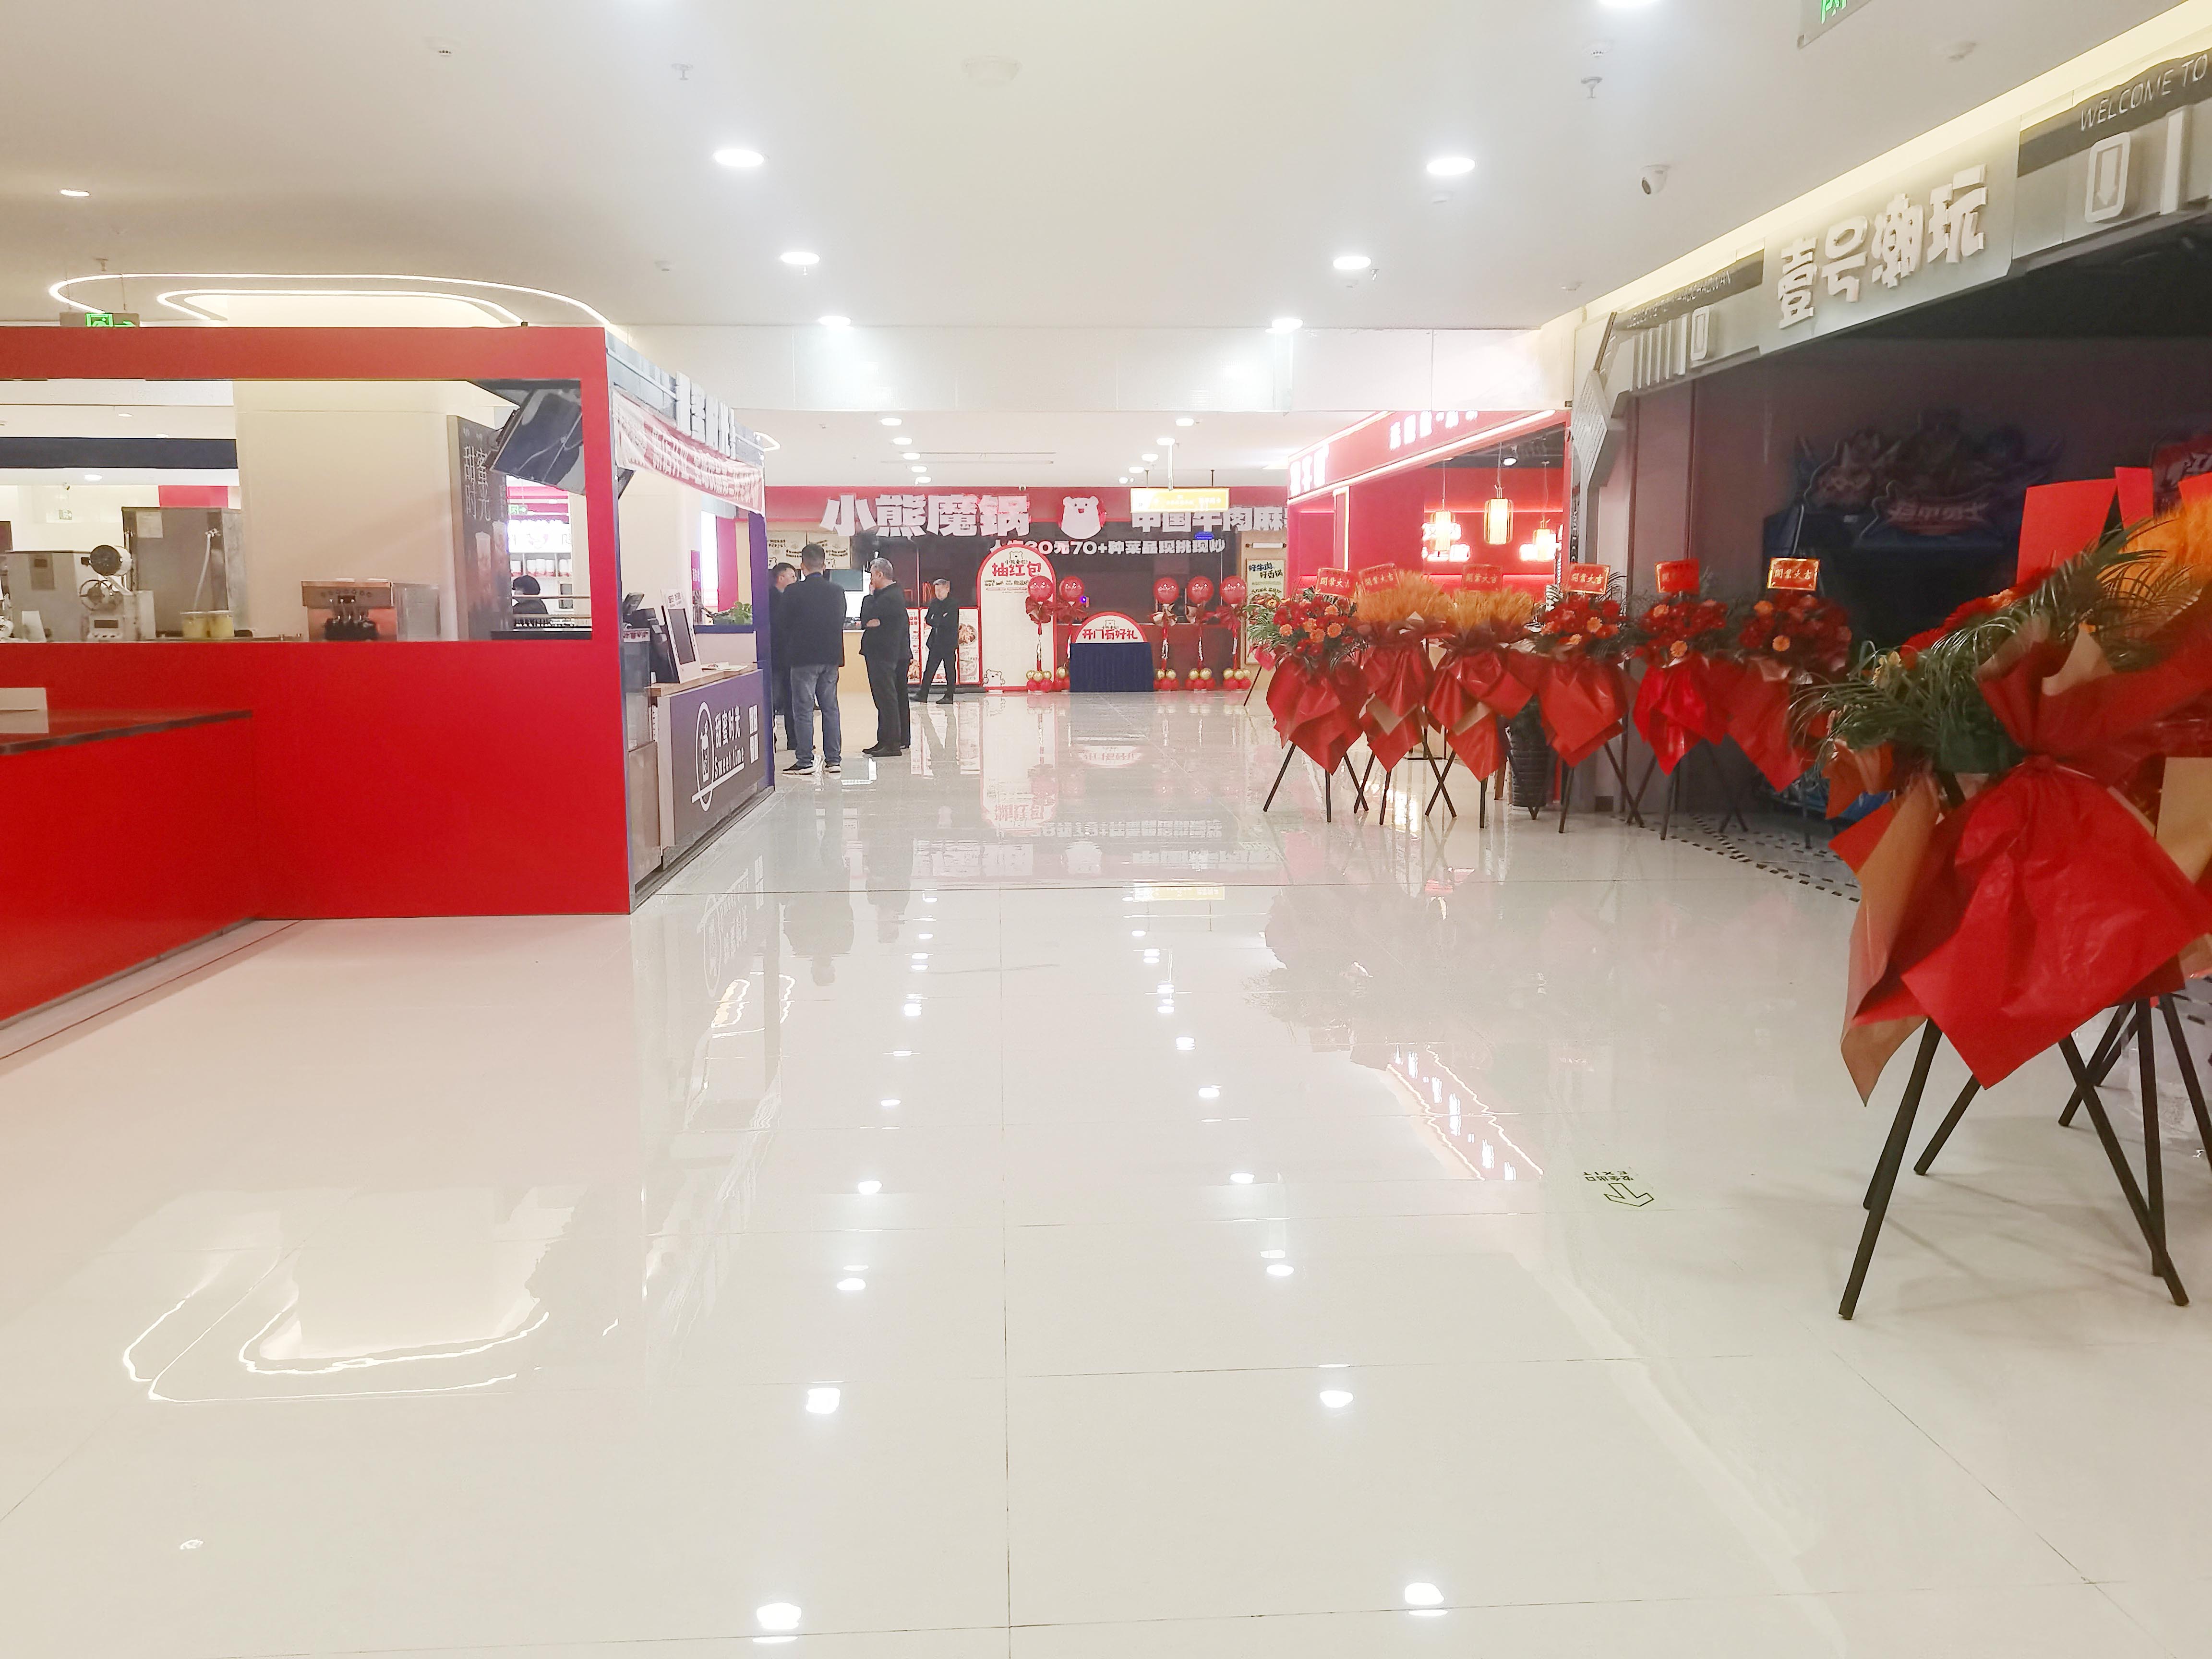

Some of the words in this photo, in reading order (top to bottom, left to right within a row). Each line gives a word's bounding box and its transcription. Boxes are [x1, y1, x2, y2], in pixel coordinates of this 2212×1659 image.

[2080, 69, 2174, 132] WELCOME
[2181, 53, 2208, 87] TO
[1778, 163, 1988, 330] 壹号潮玩
[819, 493, 1032, 537] 小熊魔锅
[1131, 506, 1287, 533] 中国牛肉麻
[991, 561, 1041, 577] 抽红包
[1082, 628, 1138, 640] 开门有好礼
[714, 750, 732, 780] Sweet
[733, 745, 745, 767] time
